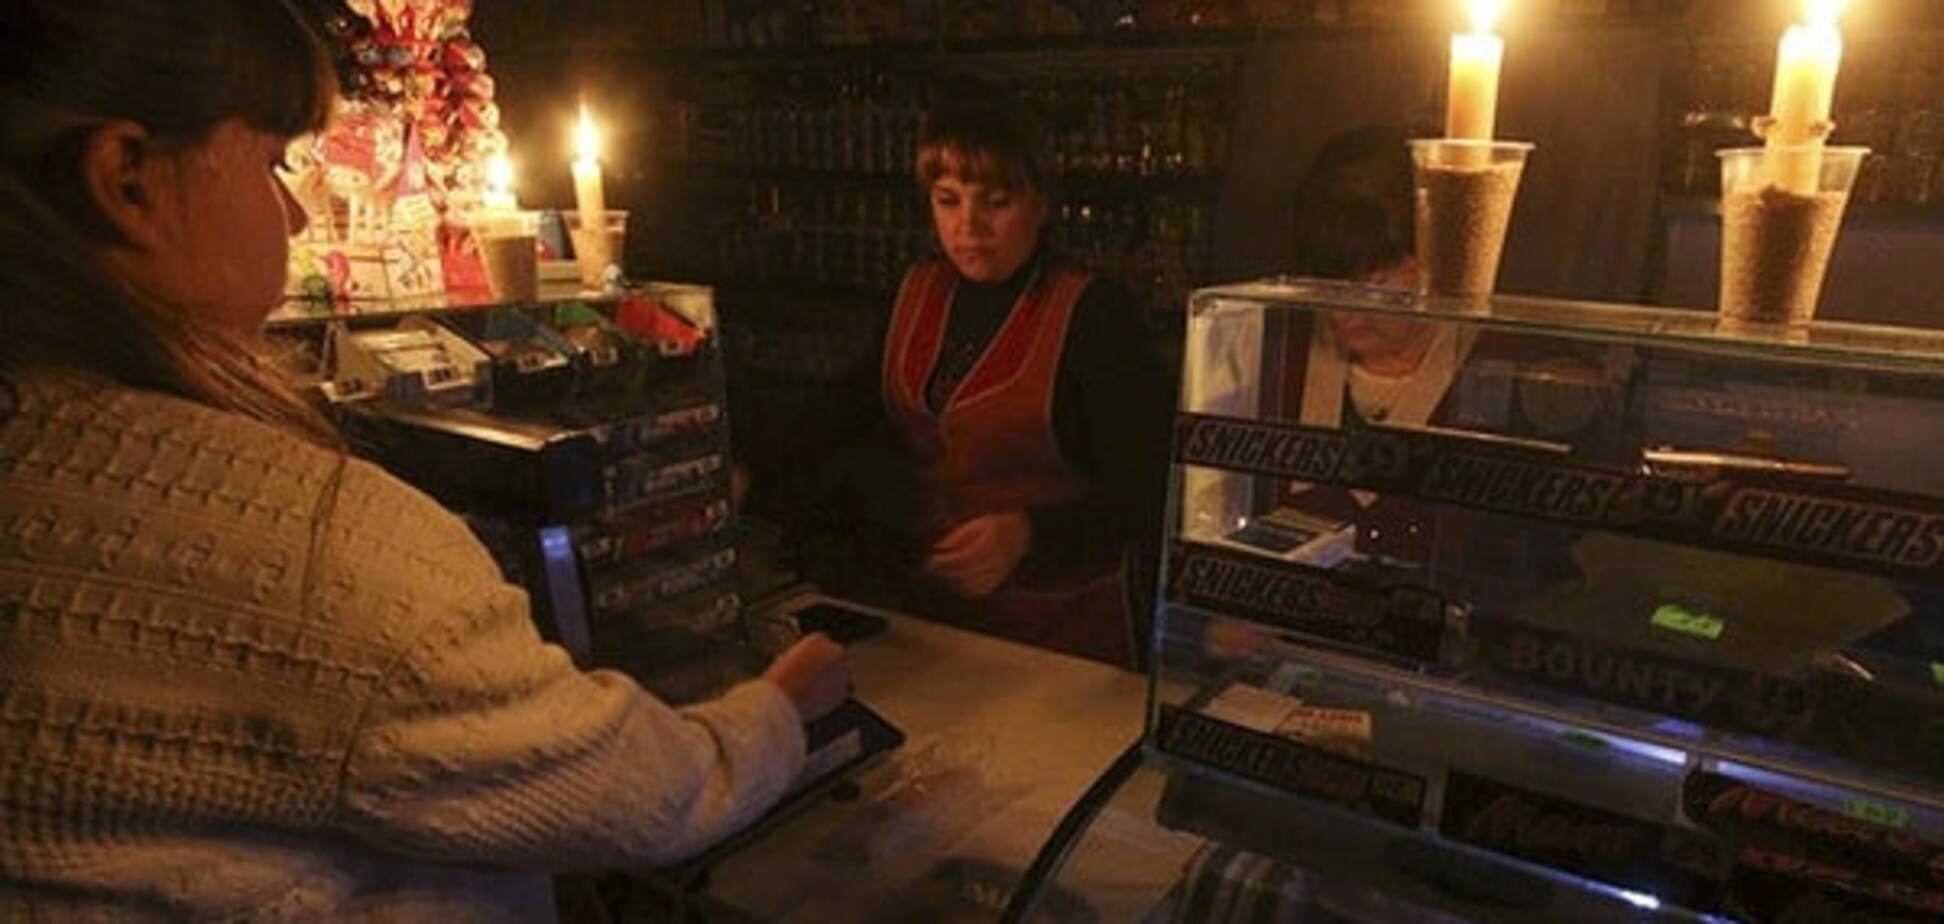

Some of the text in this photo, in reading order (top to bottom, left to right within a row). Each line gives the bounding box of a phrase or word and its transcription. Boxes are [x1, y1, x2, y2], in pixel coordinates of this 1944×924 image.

[1191, 421, 1944, 566] SNICKERS SNICKERS SNICKERS
[1187, 554, 1324, 618] SNICKERS
[1510, 635, 1720, 711] BOUNTY
